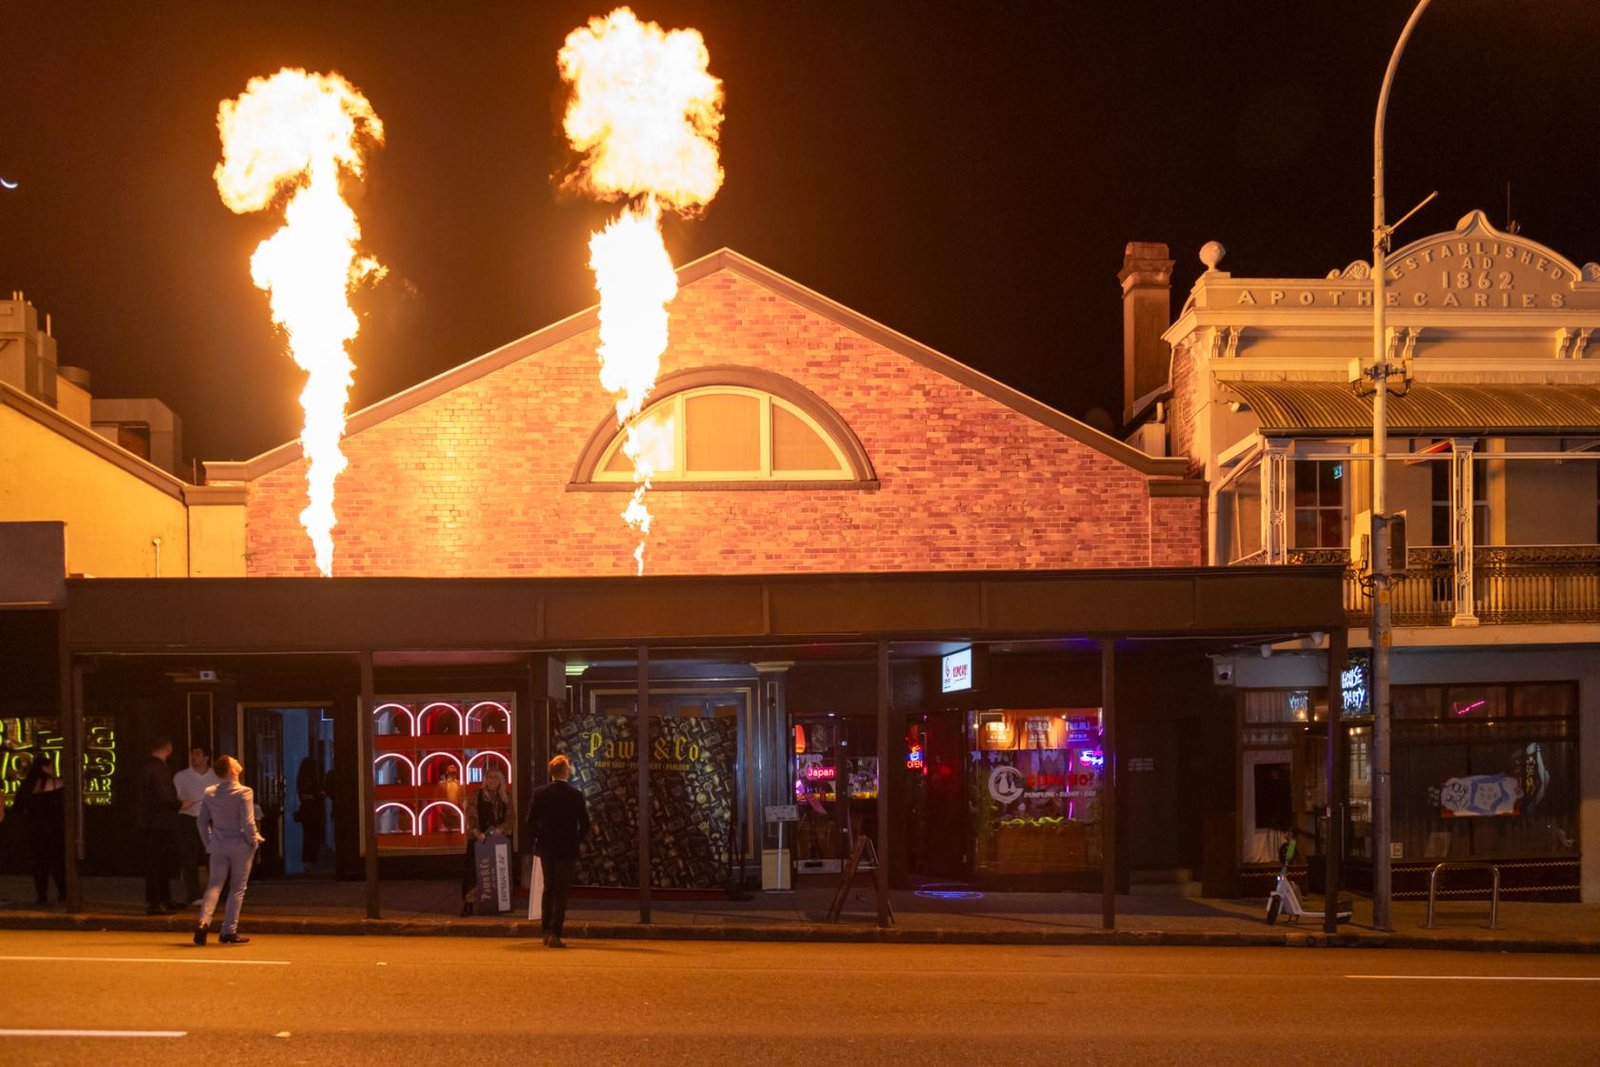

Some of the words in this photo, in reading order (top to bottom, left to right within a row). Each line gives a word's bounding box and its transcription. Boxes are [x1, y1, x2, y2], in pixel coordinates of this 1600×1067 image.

[1390, 242, 1565, 281] ESTABLISHED
[1442, 271, 1515, 290] 1862
[1237, 290, 1566, 308] APOTHECARIES
[582, 730, 638, 759] Paw
[807, 768, 834, 779] Japan
[906, 761, 922, 769] OPEN
